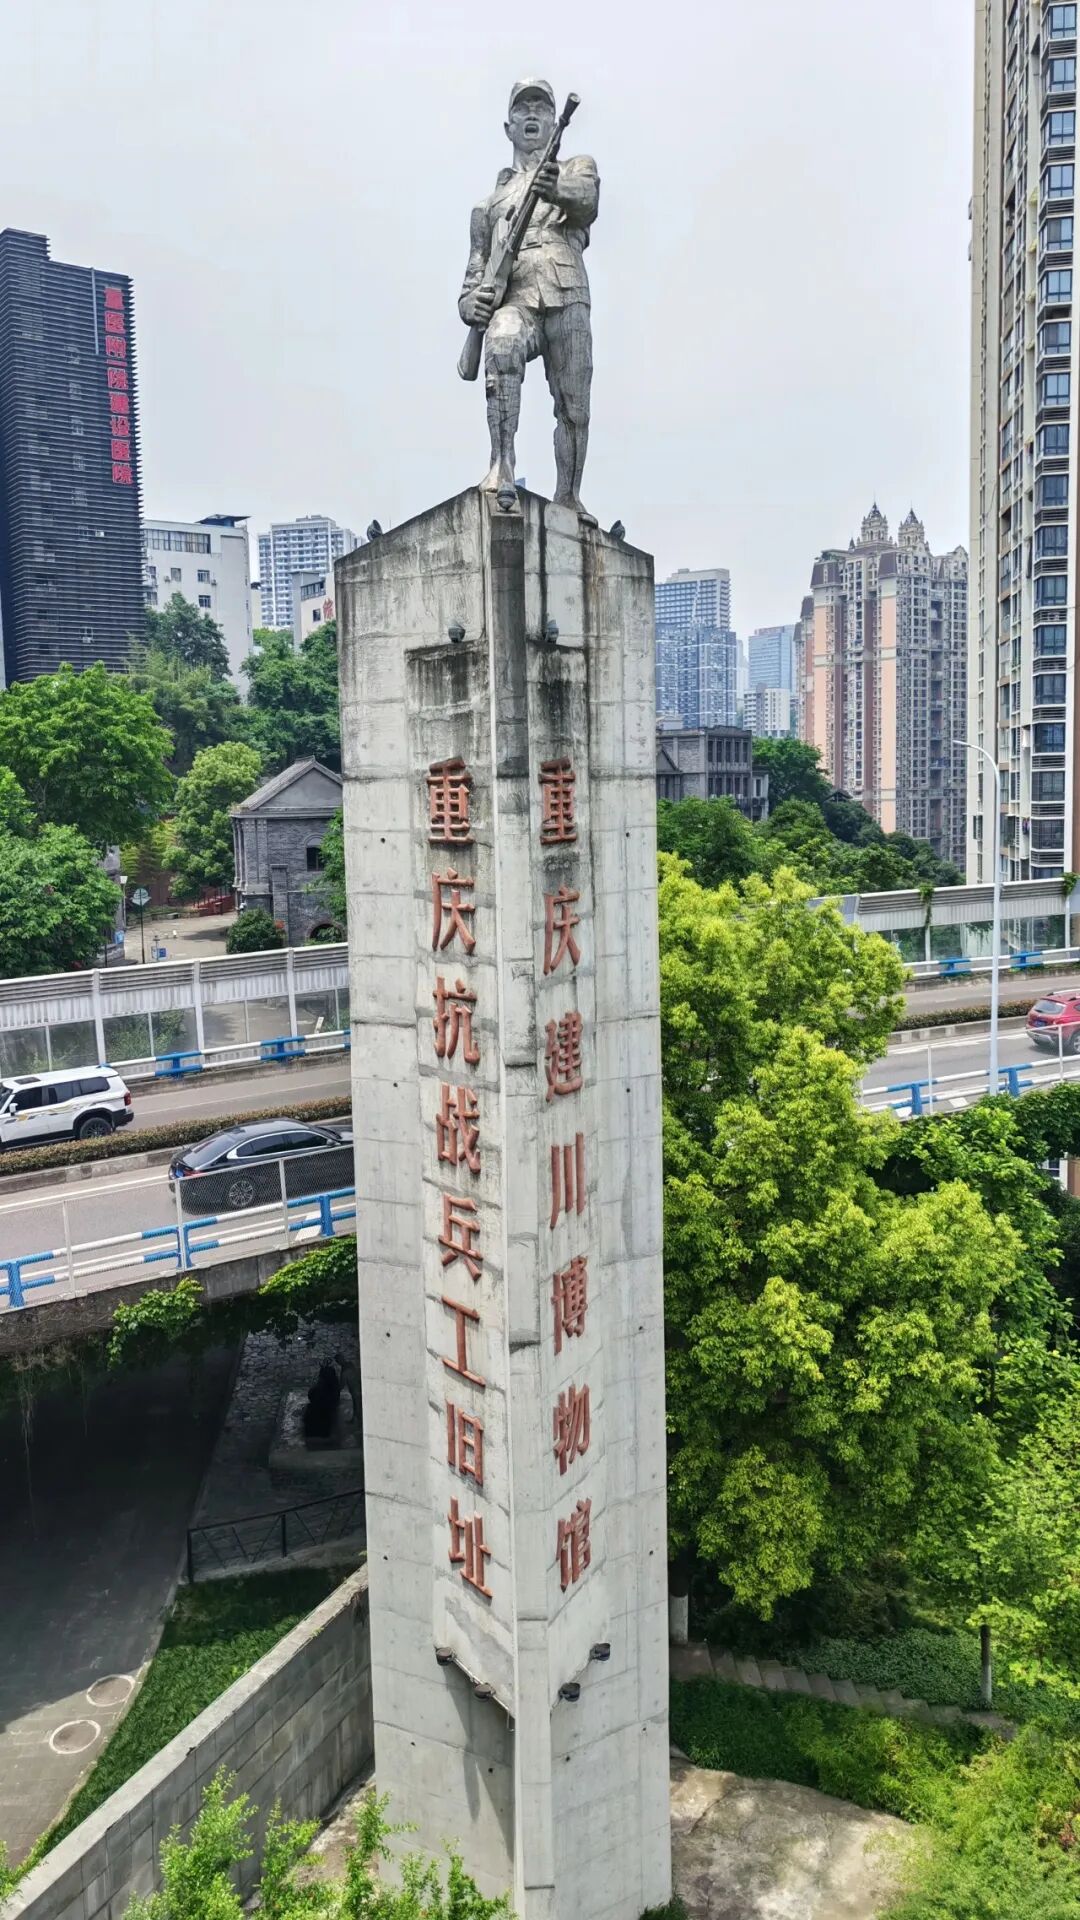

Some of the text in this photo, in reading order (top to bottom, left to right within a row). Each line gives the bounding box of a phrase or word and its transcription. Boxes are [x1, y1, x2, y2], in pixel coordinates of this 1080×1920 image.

[426, 757, 493, 1599] 重庆抗战兵工旧址
[538, 757, 591, 1592] 重庆建川博物馆
